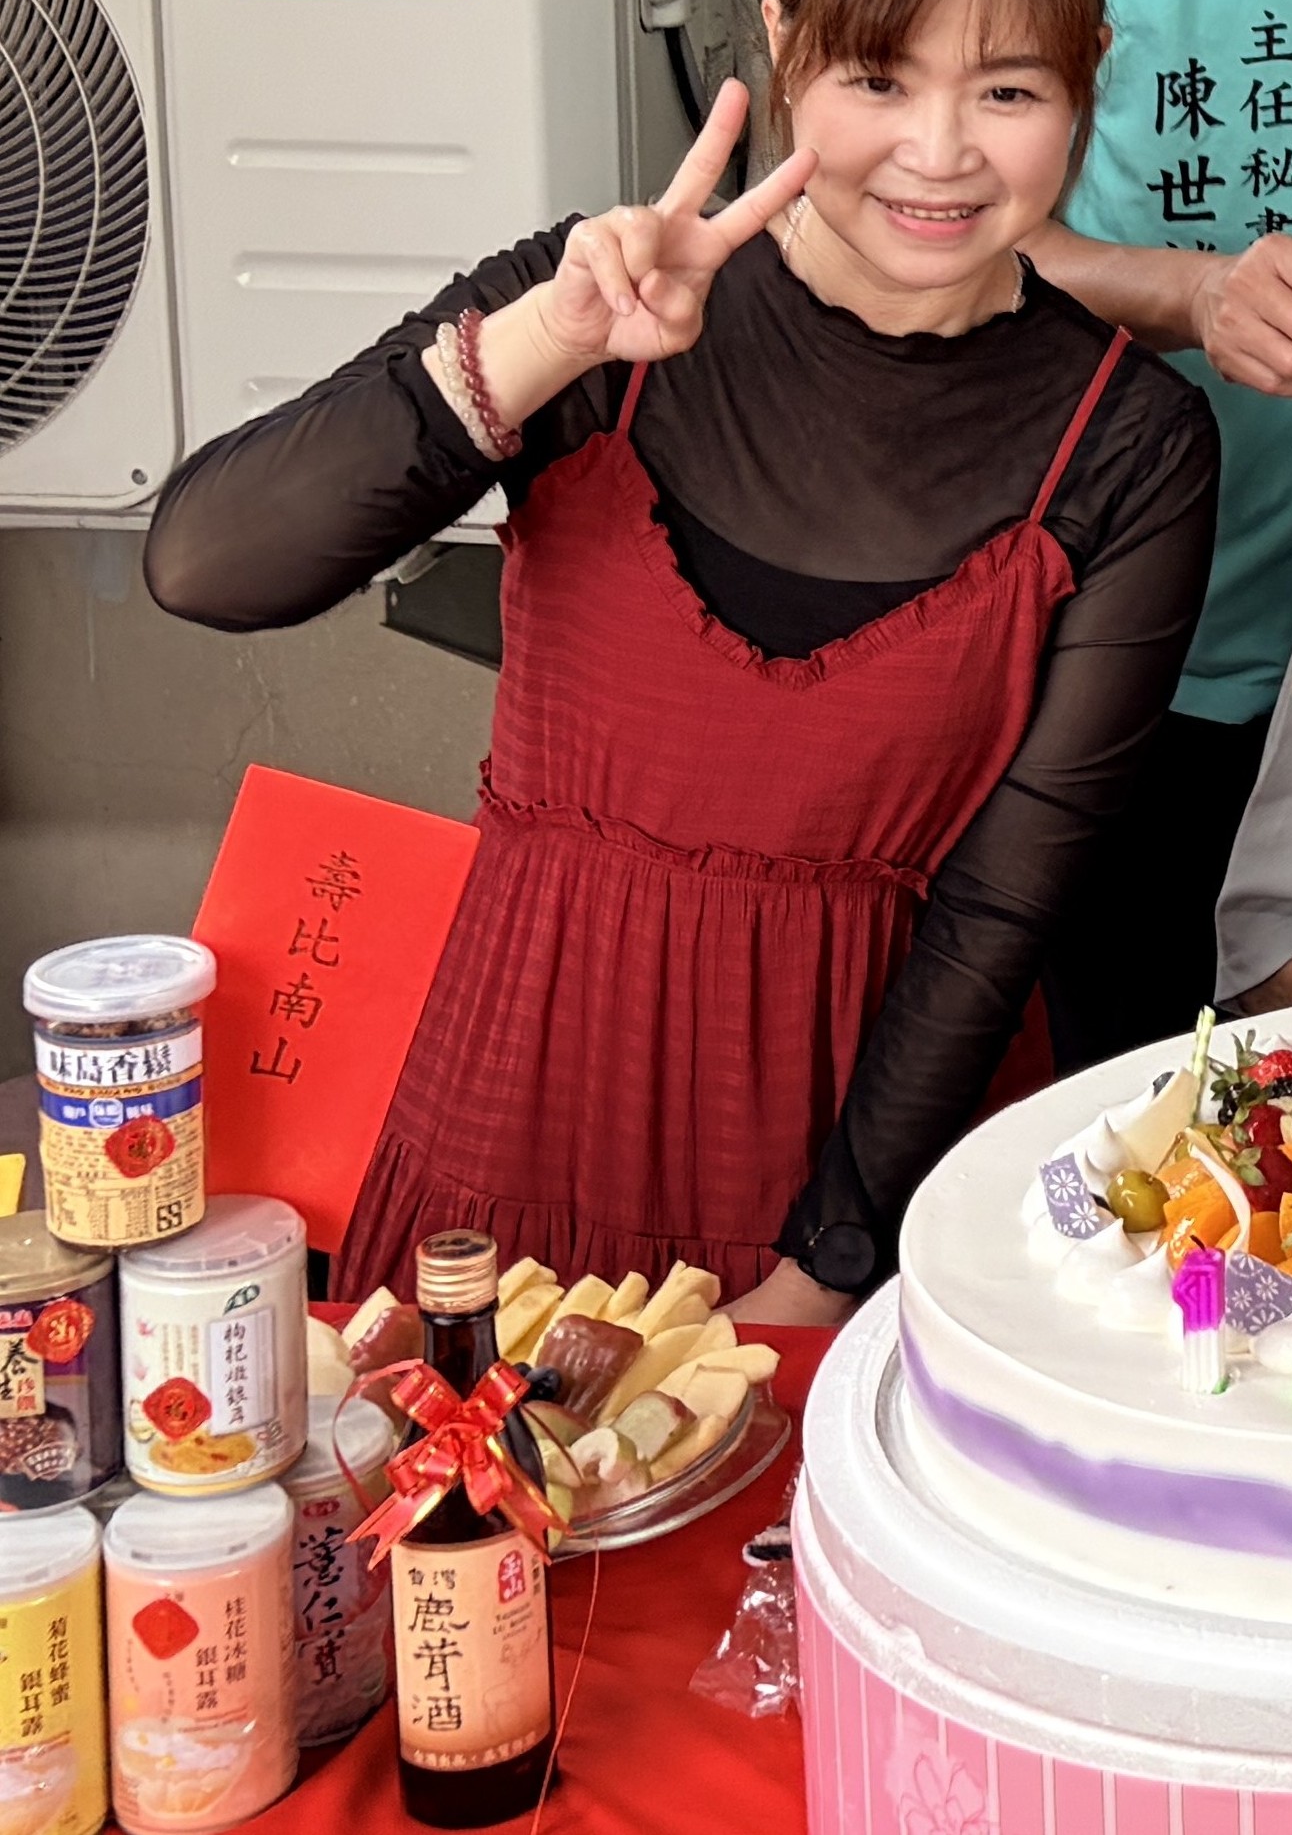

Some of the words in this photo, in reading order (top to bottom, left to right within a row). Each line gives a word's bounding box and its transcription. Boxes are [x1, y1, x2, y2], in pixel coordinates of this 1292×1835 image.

[1147, 57, 1226, 252] 陳世
[250, 850, 364, 1085] 壽比南山
[408, 1592, 470, 1732] 鹿茸酒
